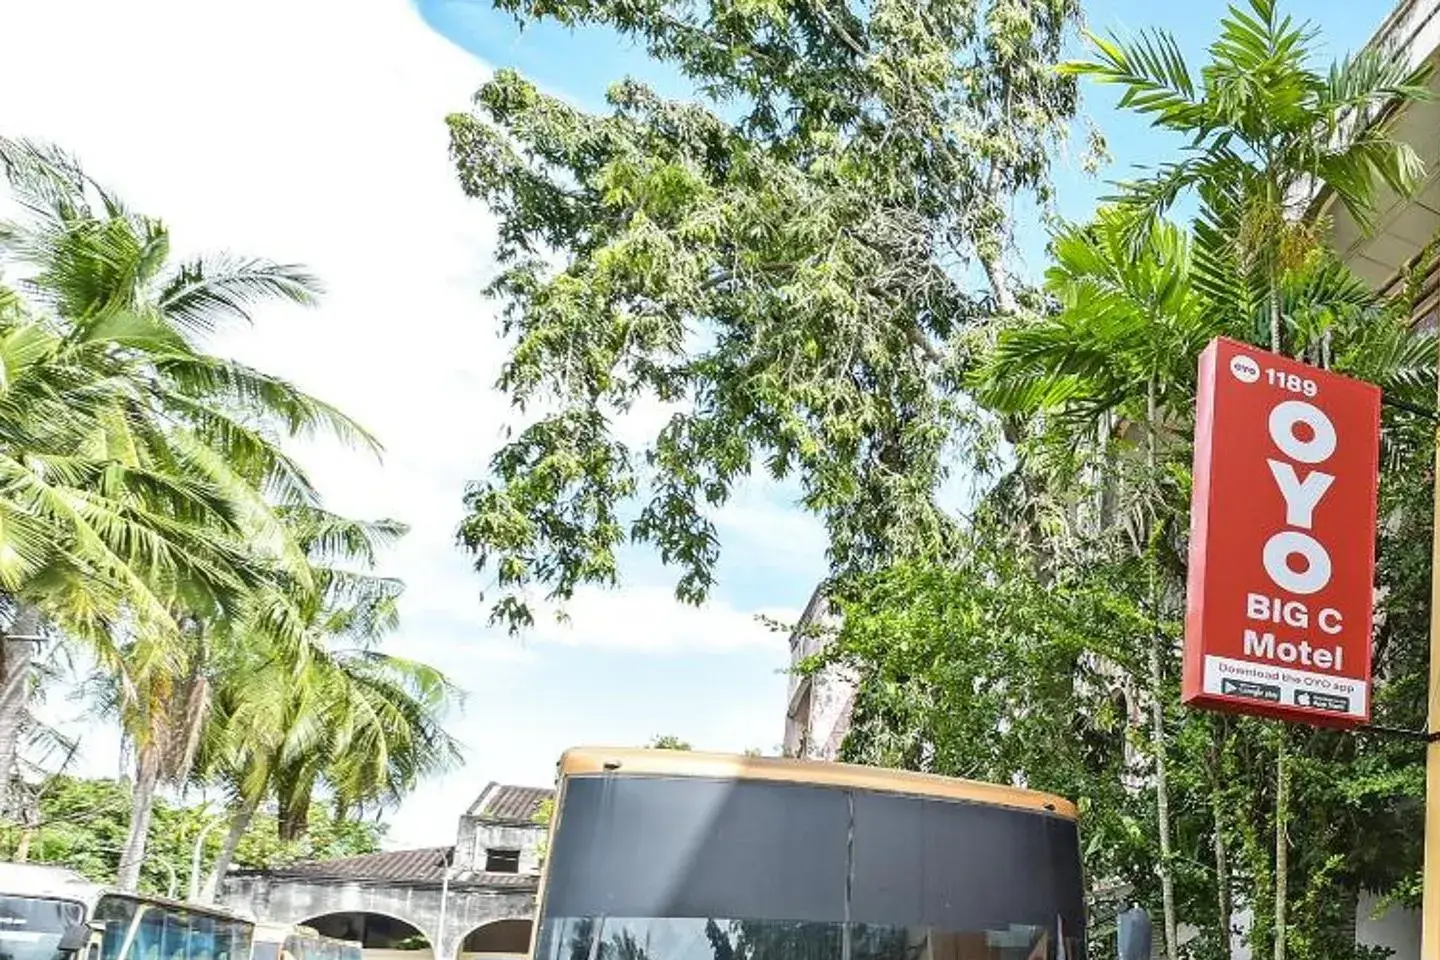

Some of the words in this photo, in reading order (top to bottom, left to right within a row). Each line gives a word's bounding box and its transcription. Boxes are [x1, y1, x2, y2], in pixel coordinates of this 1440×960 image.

[1265, 367, 1318, 398] 1189
[1262, 400, 1338, 595] OYO
[1247, 592, 1309, 629] BIG
[1318, 607, 1343, 635] C
[1243, 628, 1343, 671] Motel
[1218, 662, 1280, 681] Download
[1282, 672, 1302, 684] the
[1303, 676, 1332, 690] OYO
[1333, 683, 1355, 695] app
